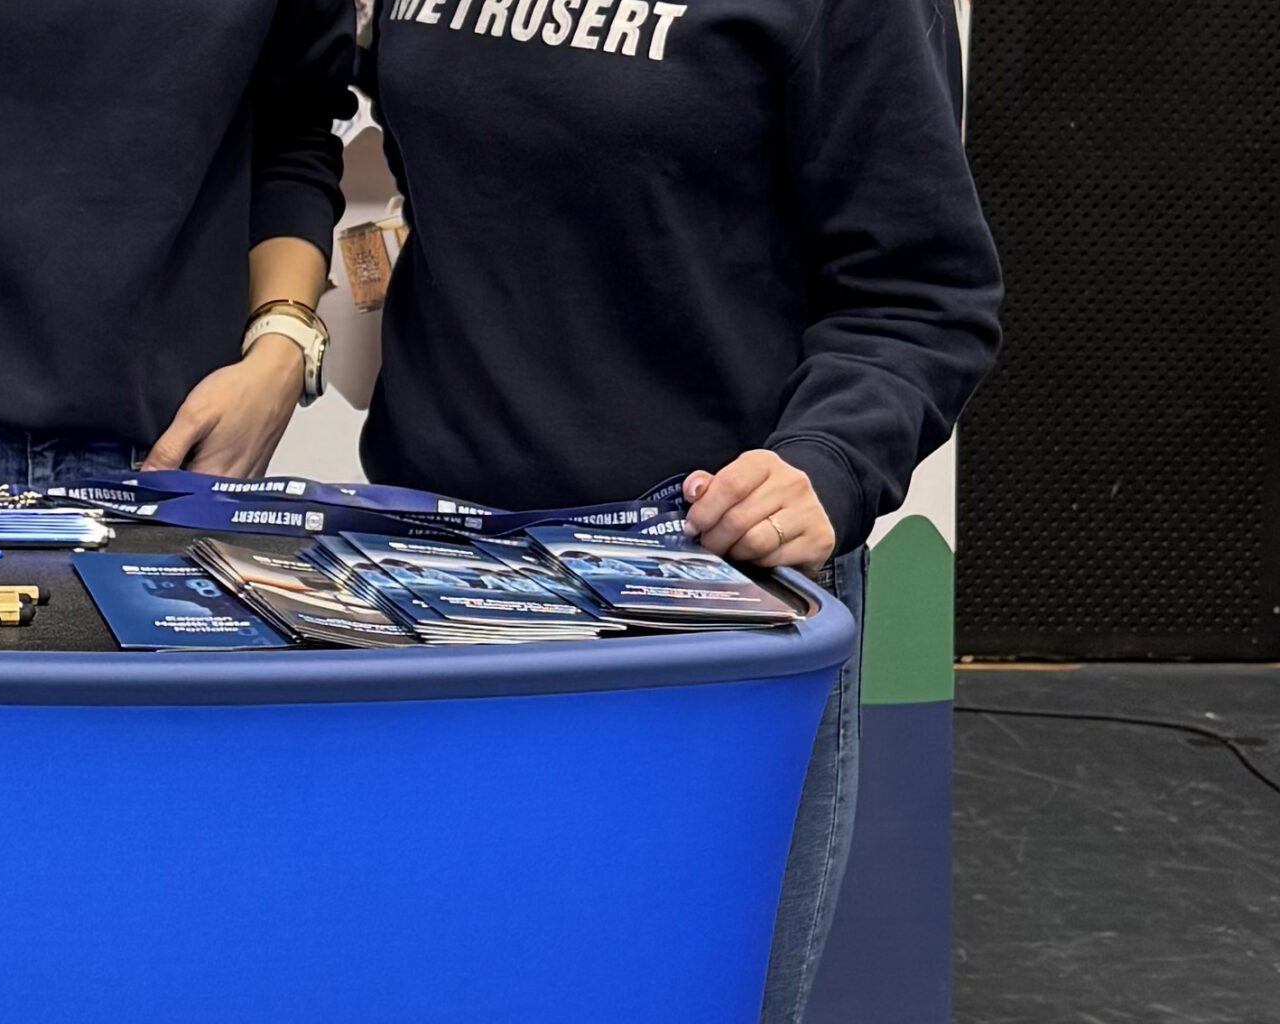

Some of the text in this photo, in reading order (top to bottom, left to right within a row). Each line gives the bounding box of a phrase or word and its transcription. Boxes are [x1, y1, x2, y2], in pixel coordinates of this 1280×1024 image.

[211, 480, 285, 493] METROSERT
[68, 487, 136, 503] METROSERT
[231, 509, 303, 527] METROSERT
